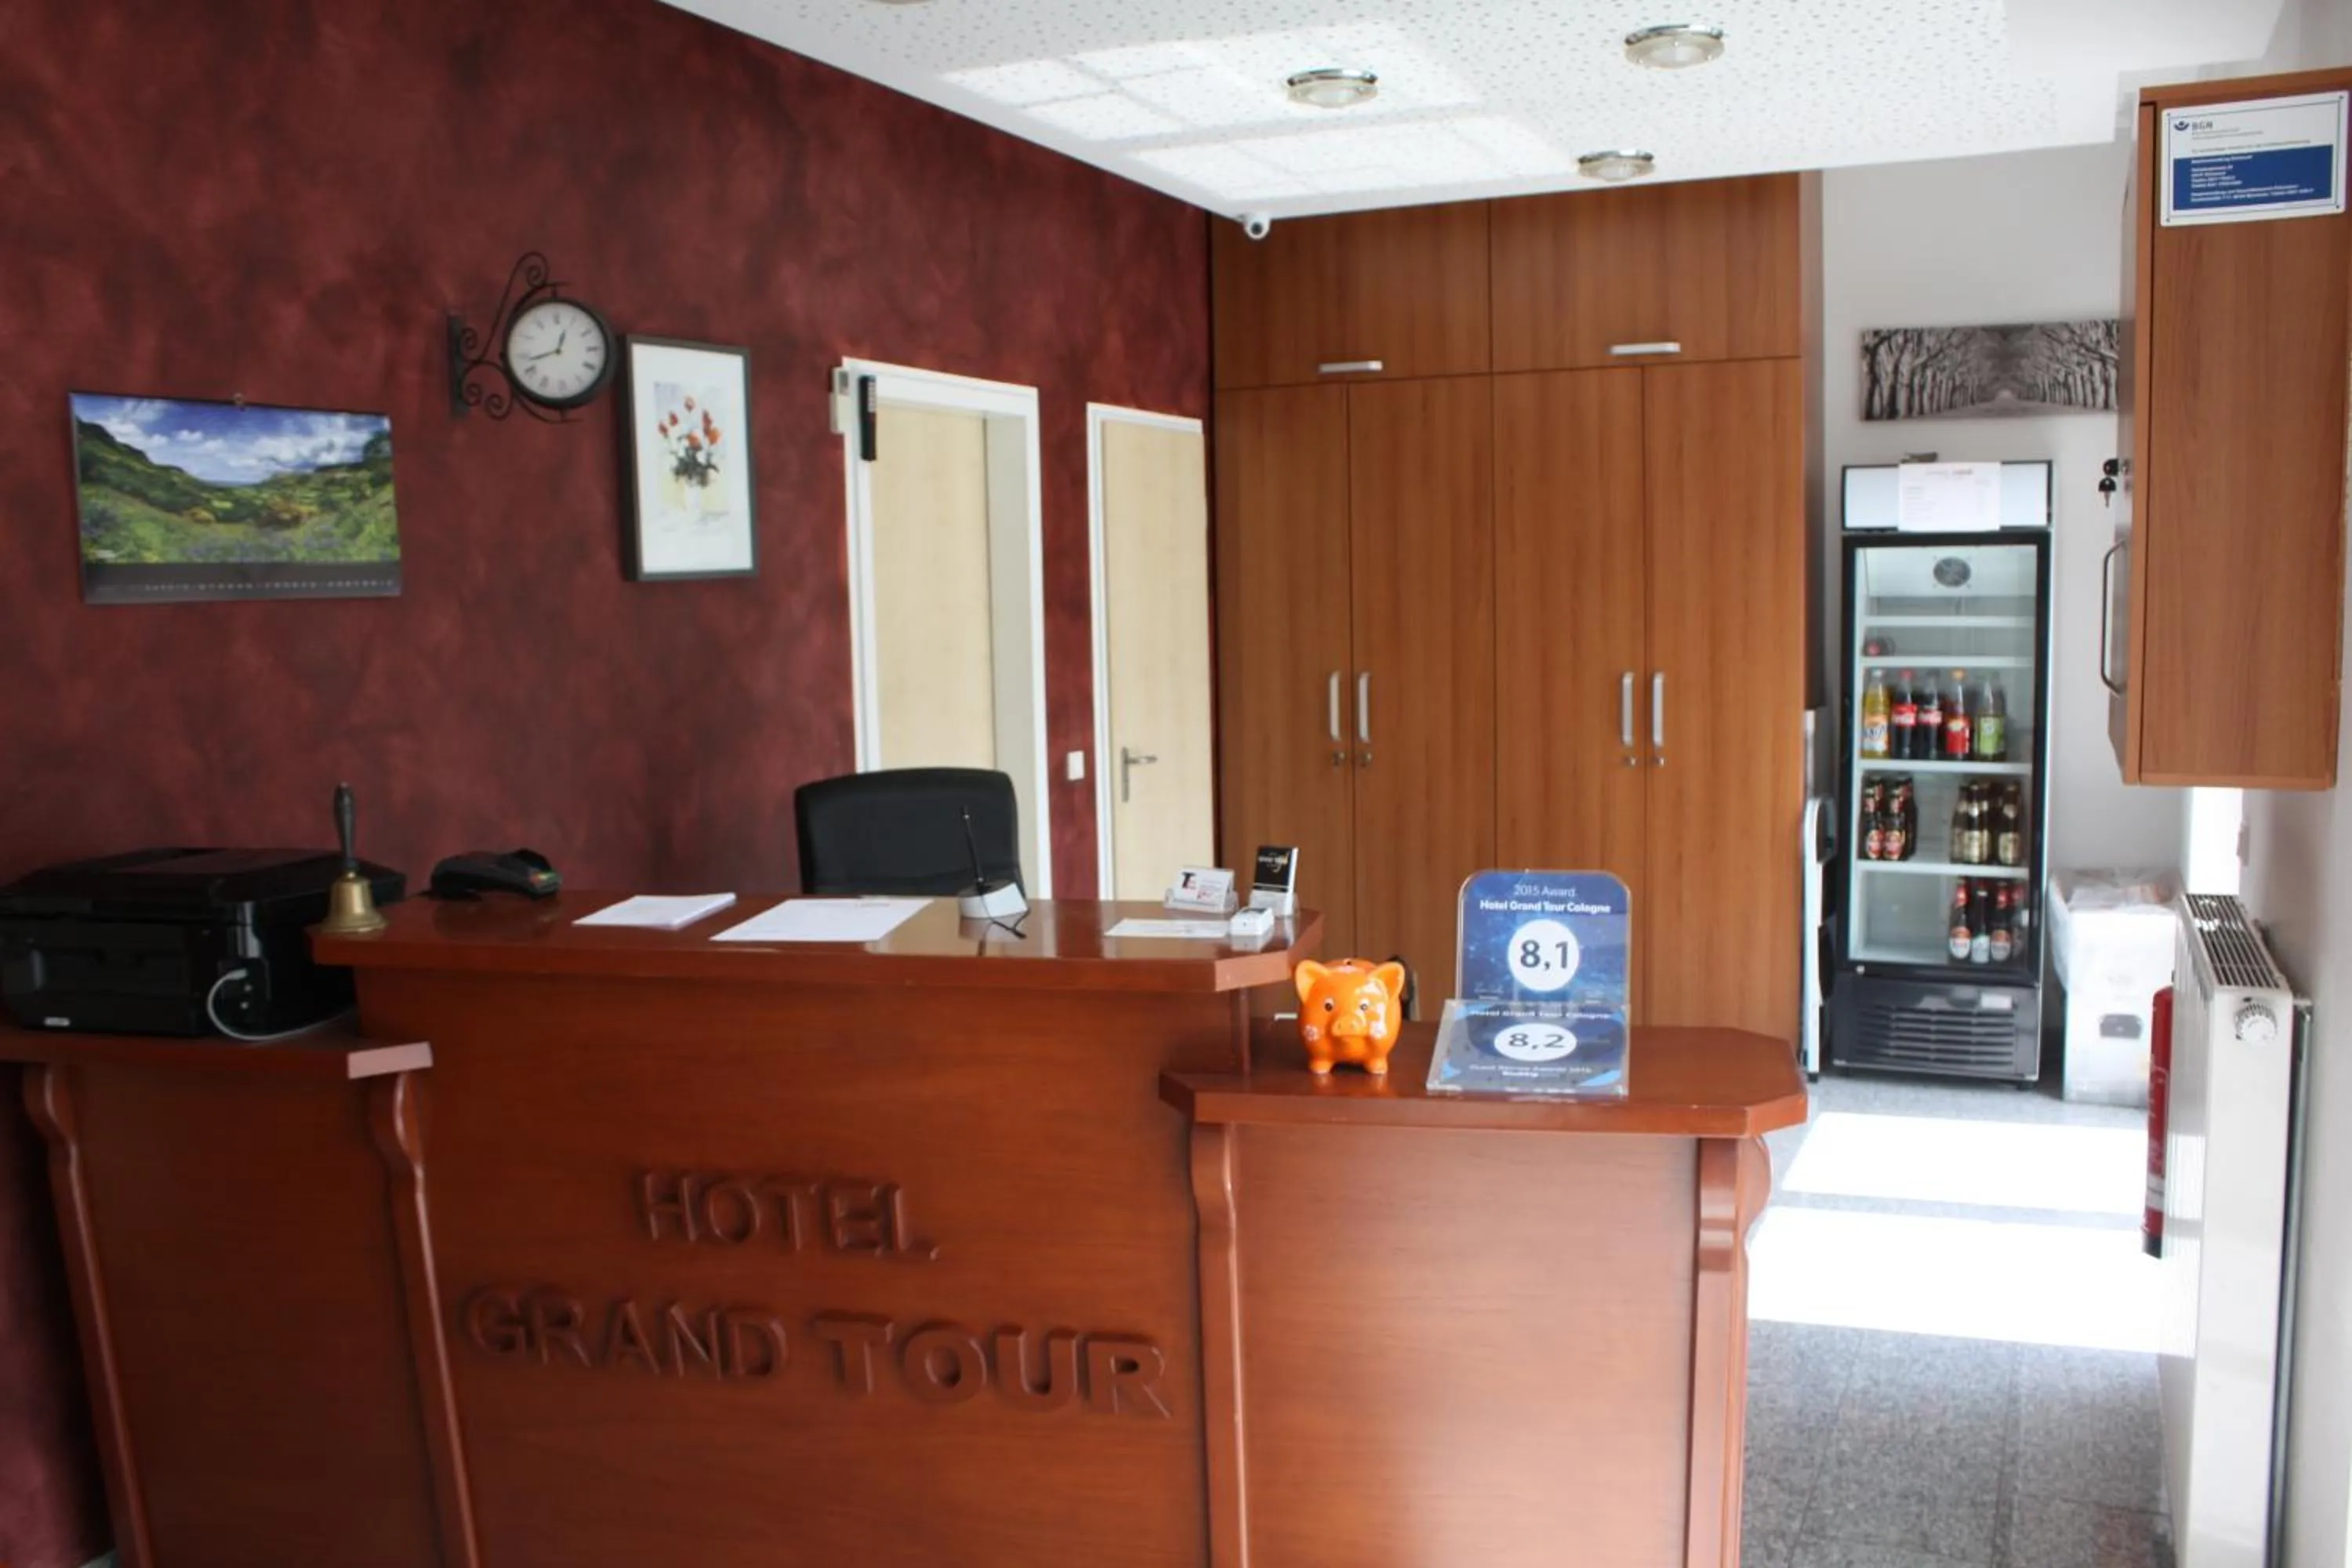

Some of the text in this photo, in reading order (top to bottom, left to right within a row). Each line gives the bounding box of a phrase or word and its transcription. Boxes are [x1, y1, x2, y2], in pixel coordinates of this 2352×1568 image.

[1513, 884, 1576, 898] 2015 Award
[1479, 899, 1611, 915] Hotel Grand Tour Cologne
[1519, 939, 1568, 971] 8,1
[1508, 1033, 1565, 1050] 8,2
[638, 1167, 941, 1261] HOTEL
[463, 1284, 1172, 1420] GRAND TOUR
